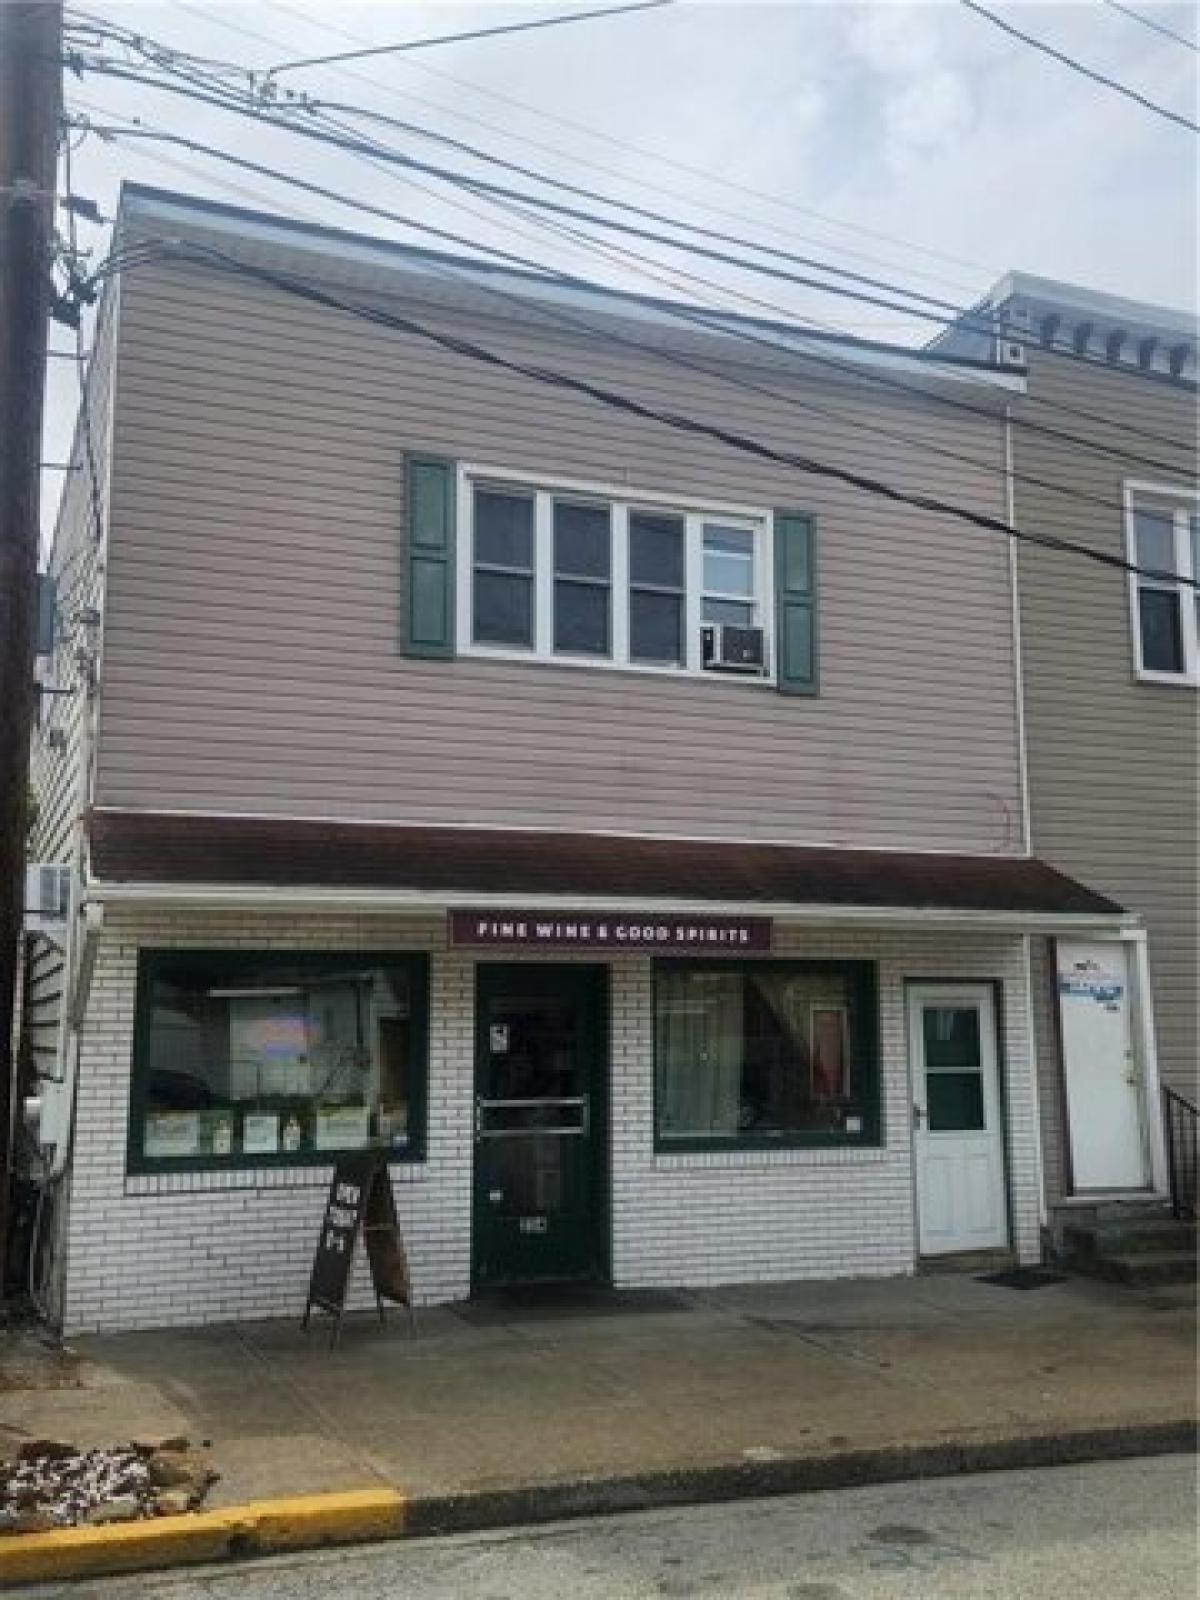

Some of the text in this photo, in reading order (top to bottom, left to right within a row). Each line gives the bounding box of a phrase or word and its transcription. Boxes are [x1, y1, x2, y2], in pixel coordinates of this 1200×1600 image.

[476, 922, 527, 938] FINE
[536, 922, 591, 939] WINE
[615, 925, 671, 941] GOOD
[675, 926, 749, 943] SPIRITS
